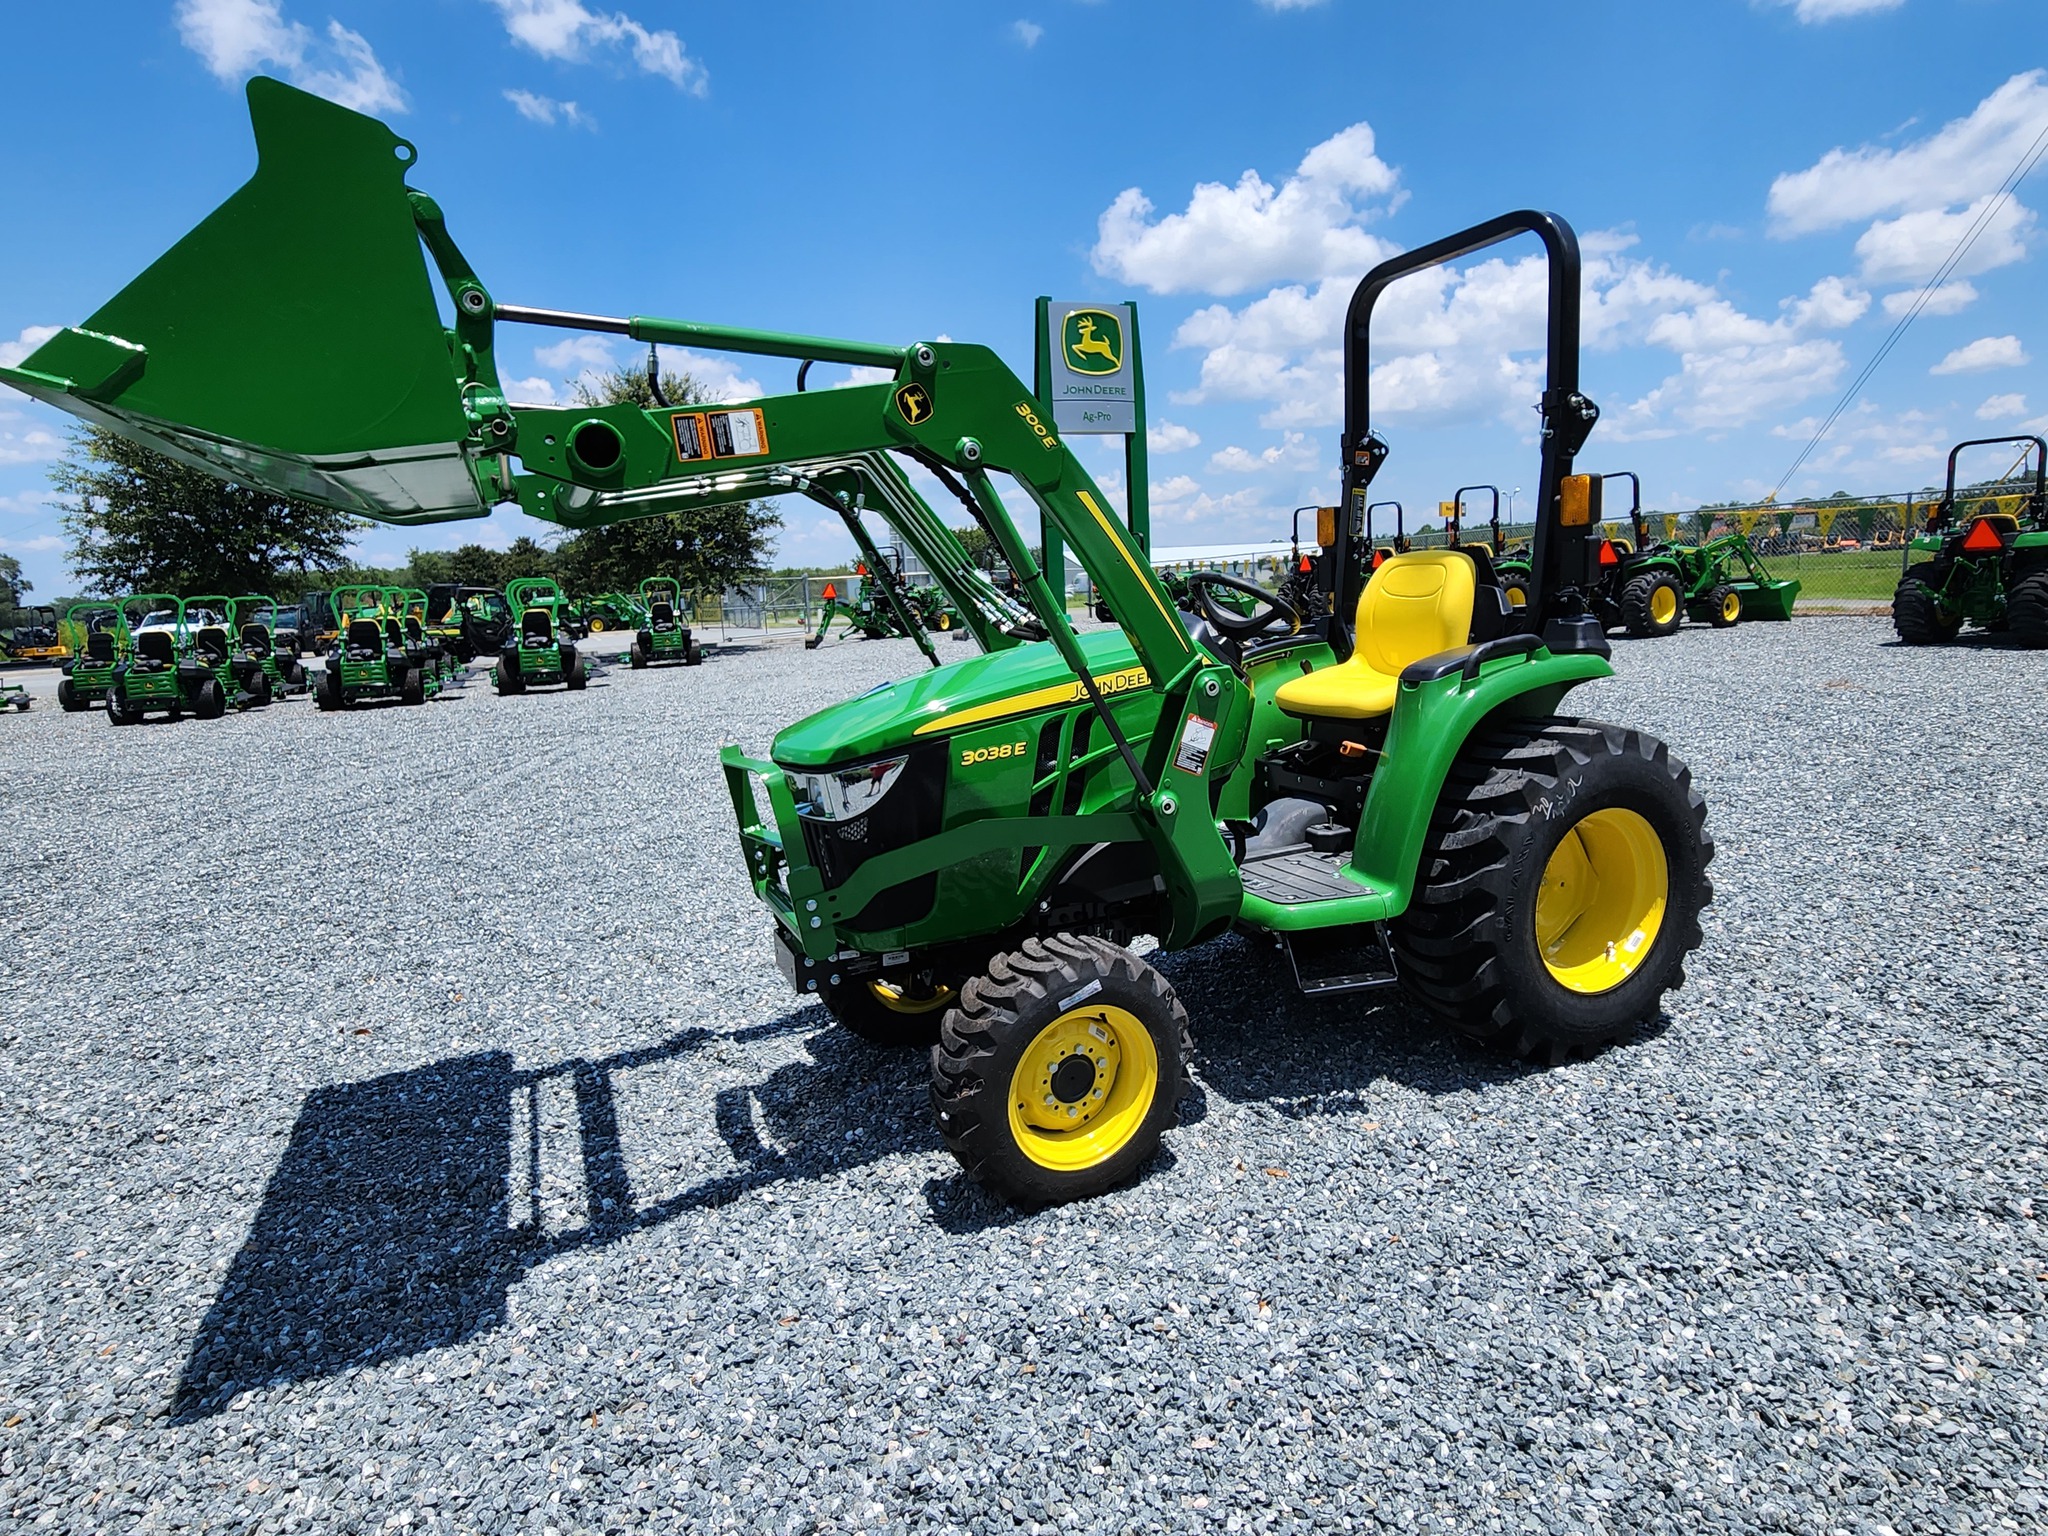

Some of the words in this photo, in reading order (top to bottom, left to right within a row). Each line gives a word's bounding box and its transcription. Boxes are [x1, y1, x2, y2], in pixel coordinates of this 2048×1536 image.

[1062, 385, 1092, 395] JOHN
[1094, 385, 1126, 395] DEERE
[1082, 411, 1112, 423] Ag-Pro
